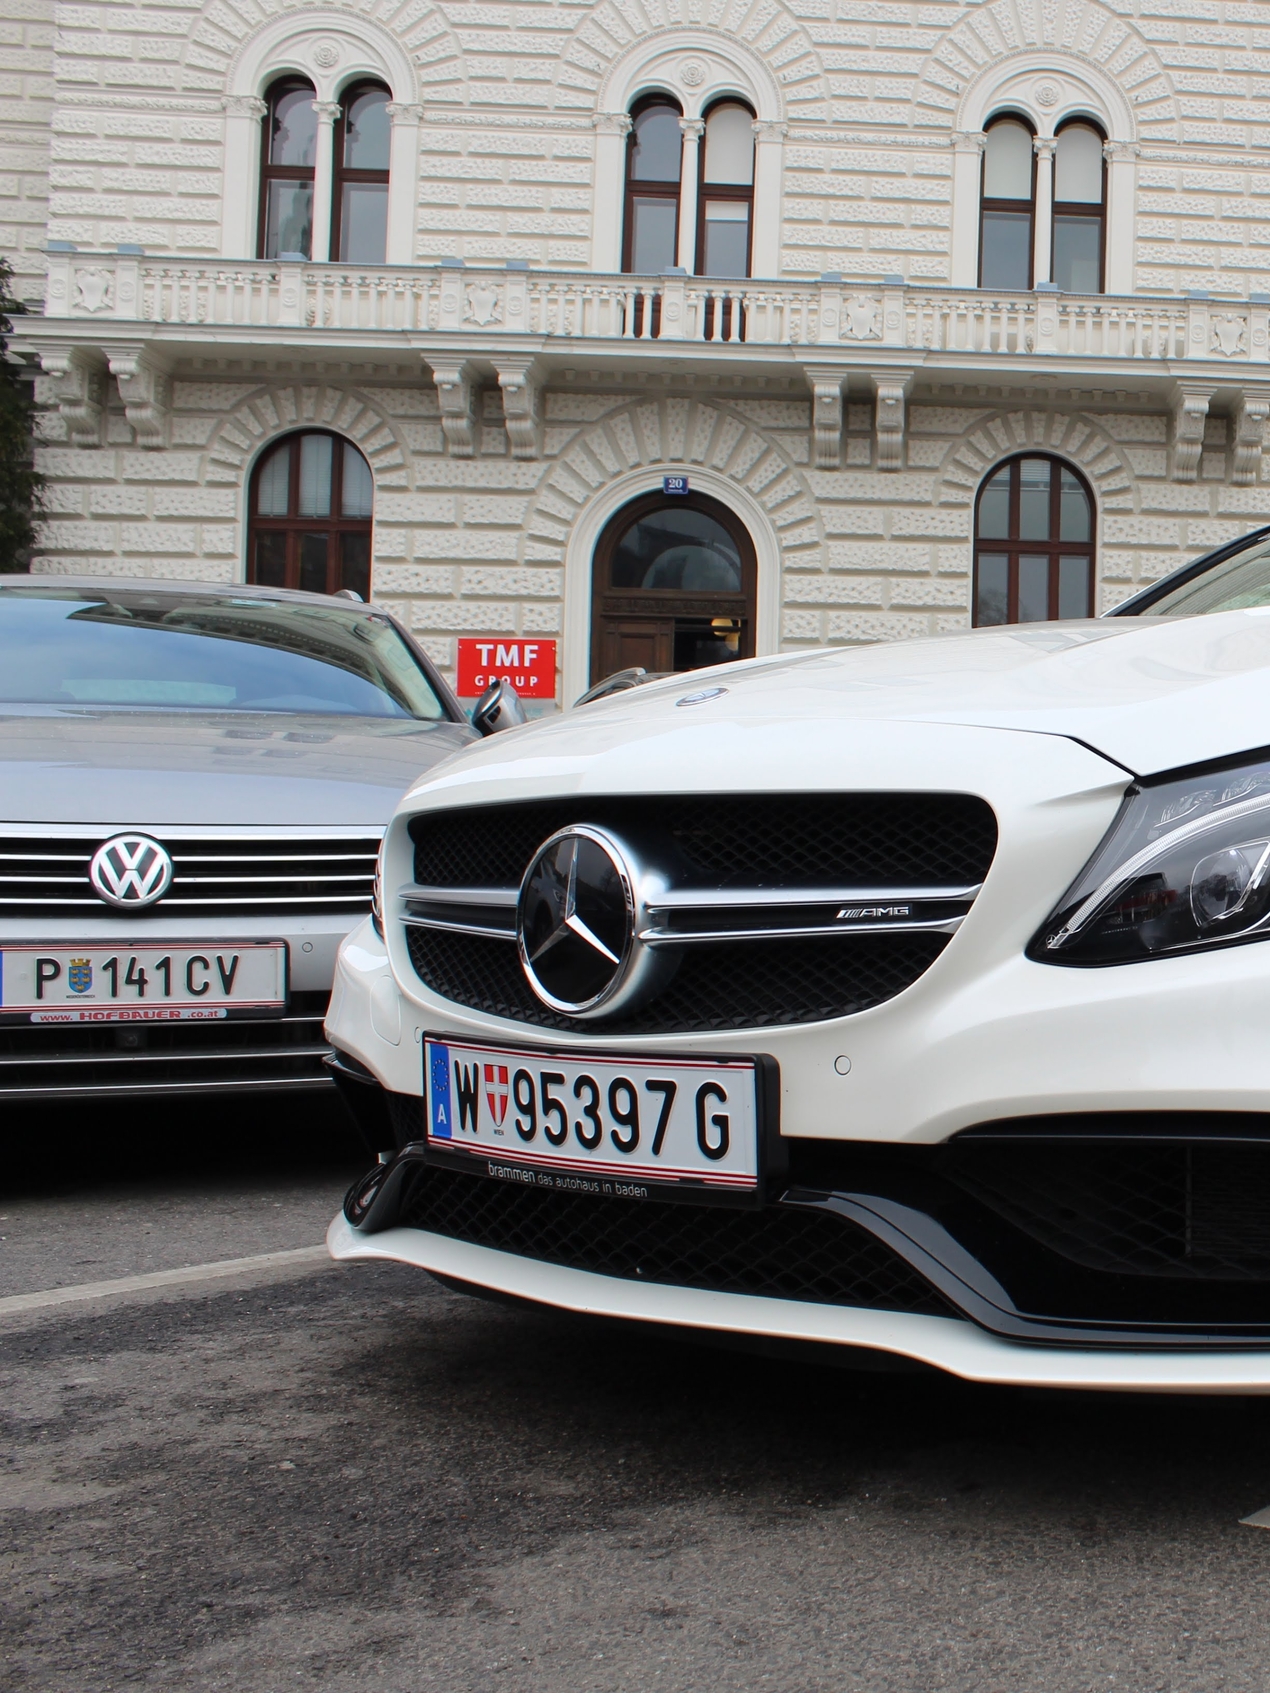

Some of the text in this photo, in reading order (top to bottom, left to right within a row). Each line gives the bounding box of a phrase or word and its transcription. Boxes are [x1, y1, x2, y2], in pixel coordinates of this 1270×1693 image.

[668, 478, 683, 488] 20
[475, 644, 539, 667] TMF
[474, 675, 538, 687] GROUP
[36, 957, 61, 999] P
[79, 1010, 182, 1020] HOFBAUER
[436, 1104, 447, 1124] A
[455, 1060, 730, 1160] W 95397 G
[488, 1161, 648, 1197] brammen das autohaus in baden
